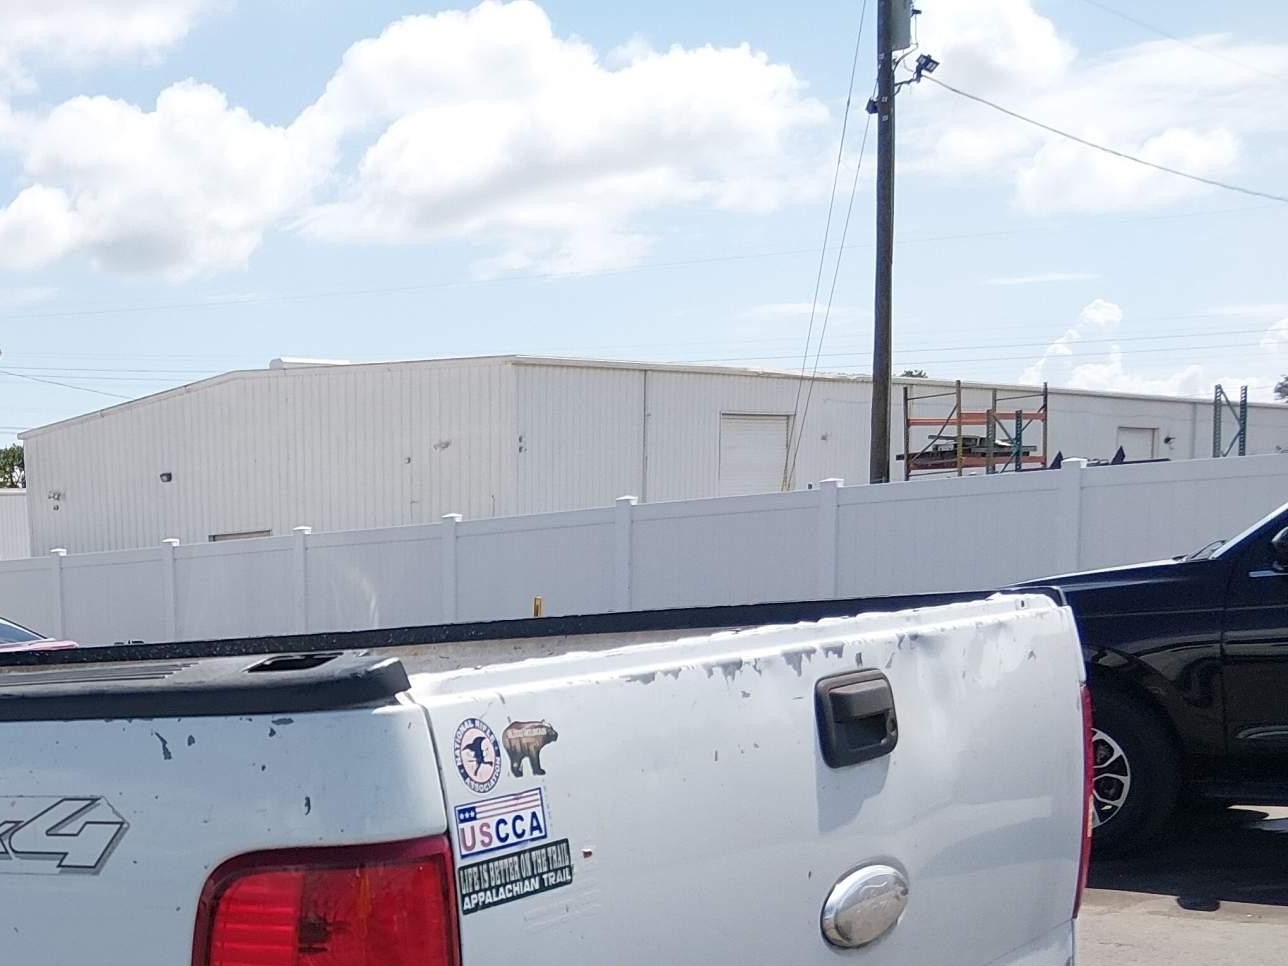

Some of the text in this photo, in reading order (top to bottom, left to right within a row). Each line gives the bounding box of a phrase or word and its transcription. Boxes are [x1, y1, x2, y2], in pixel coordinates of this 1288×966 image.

[460, 811, 544, 852] USCCA
[459, 842, 570, 895] LIFE IS BETTER ON THE TRAIL
[463, 867, 572, 910] APPALACHIAN TRAIL
